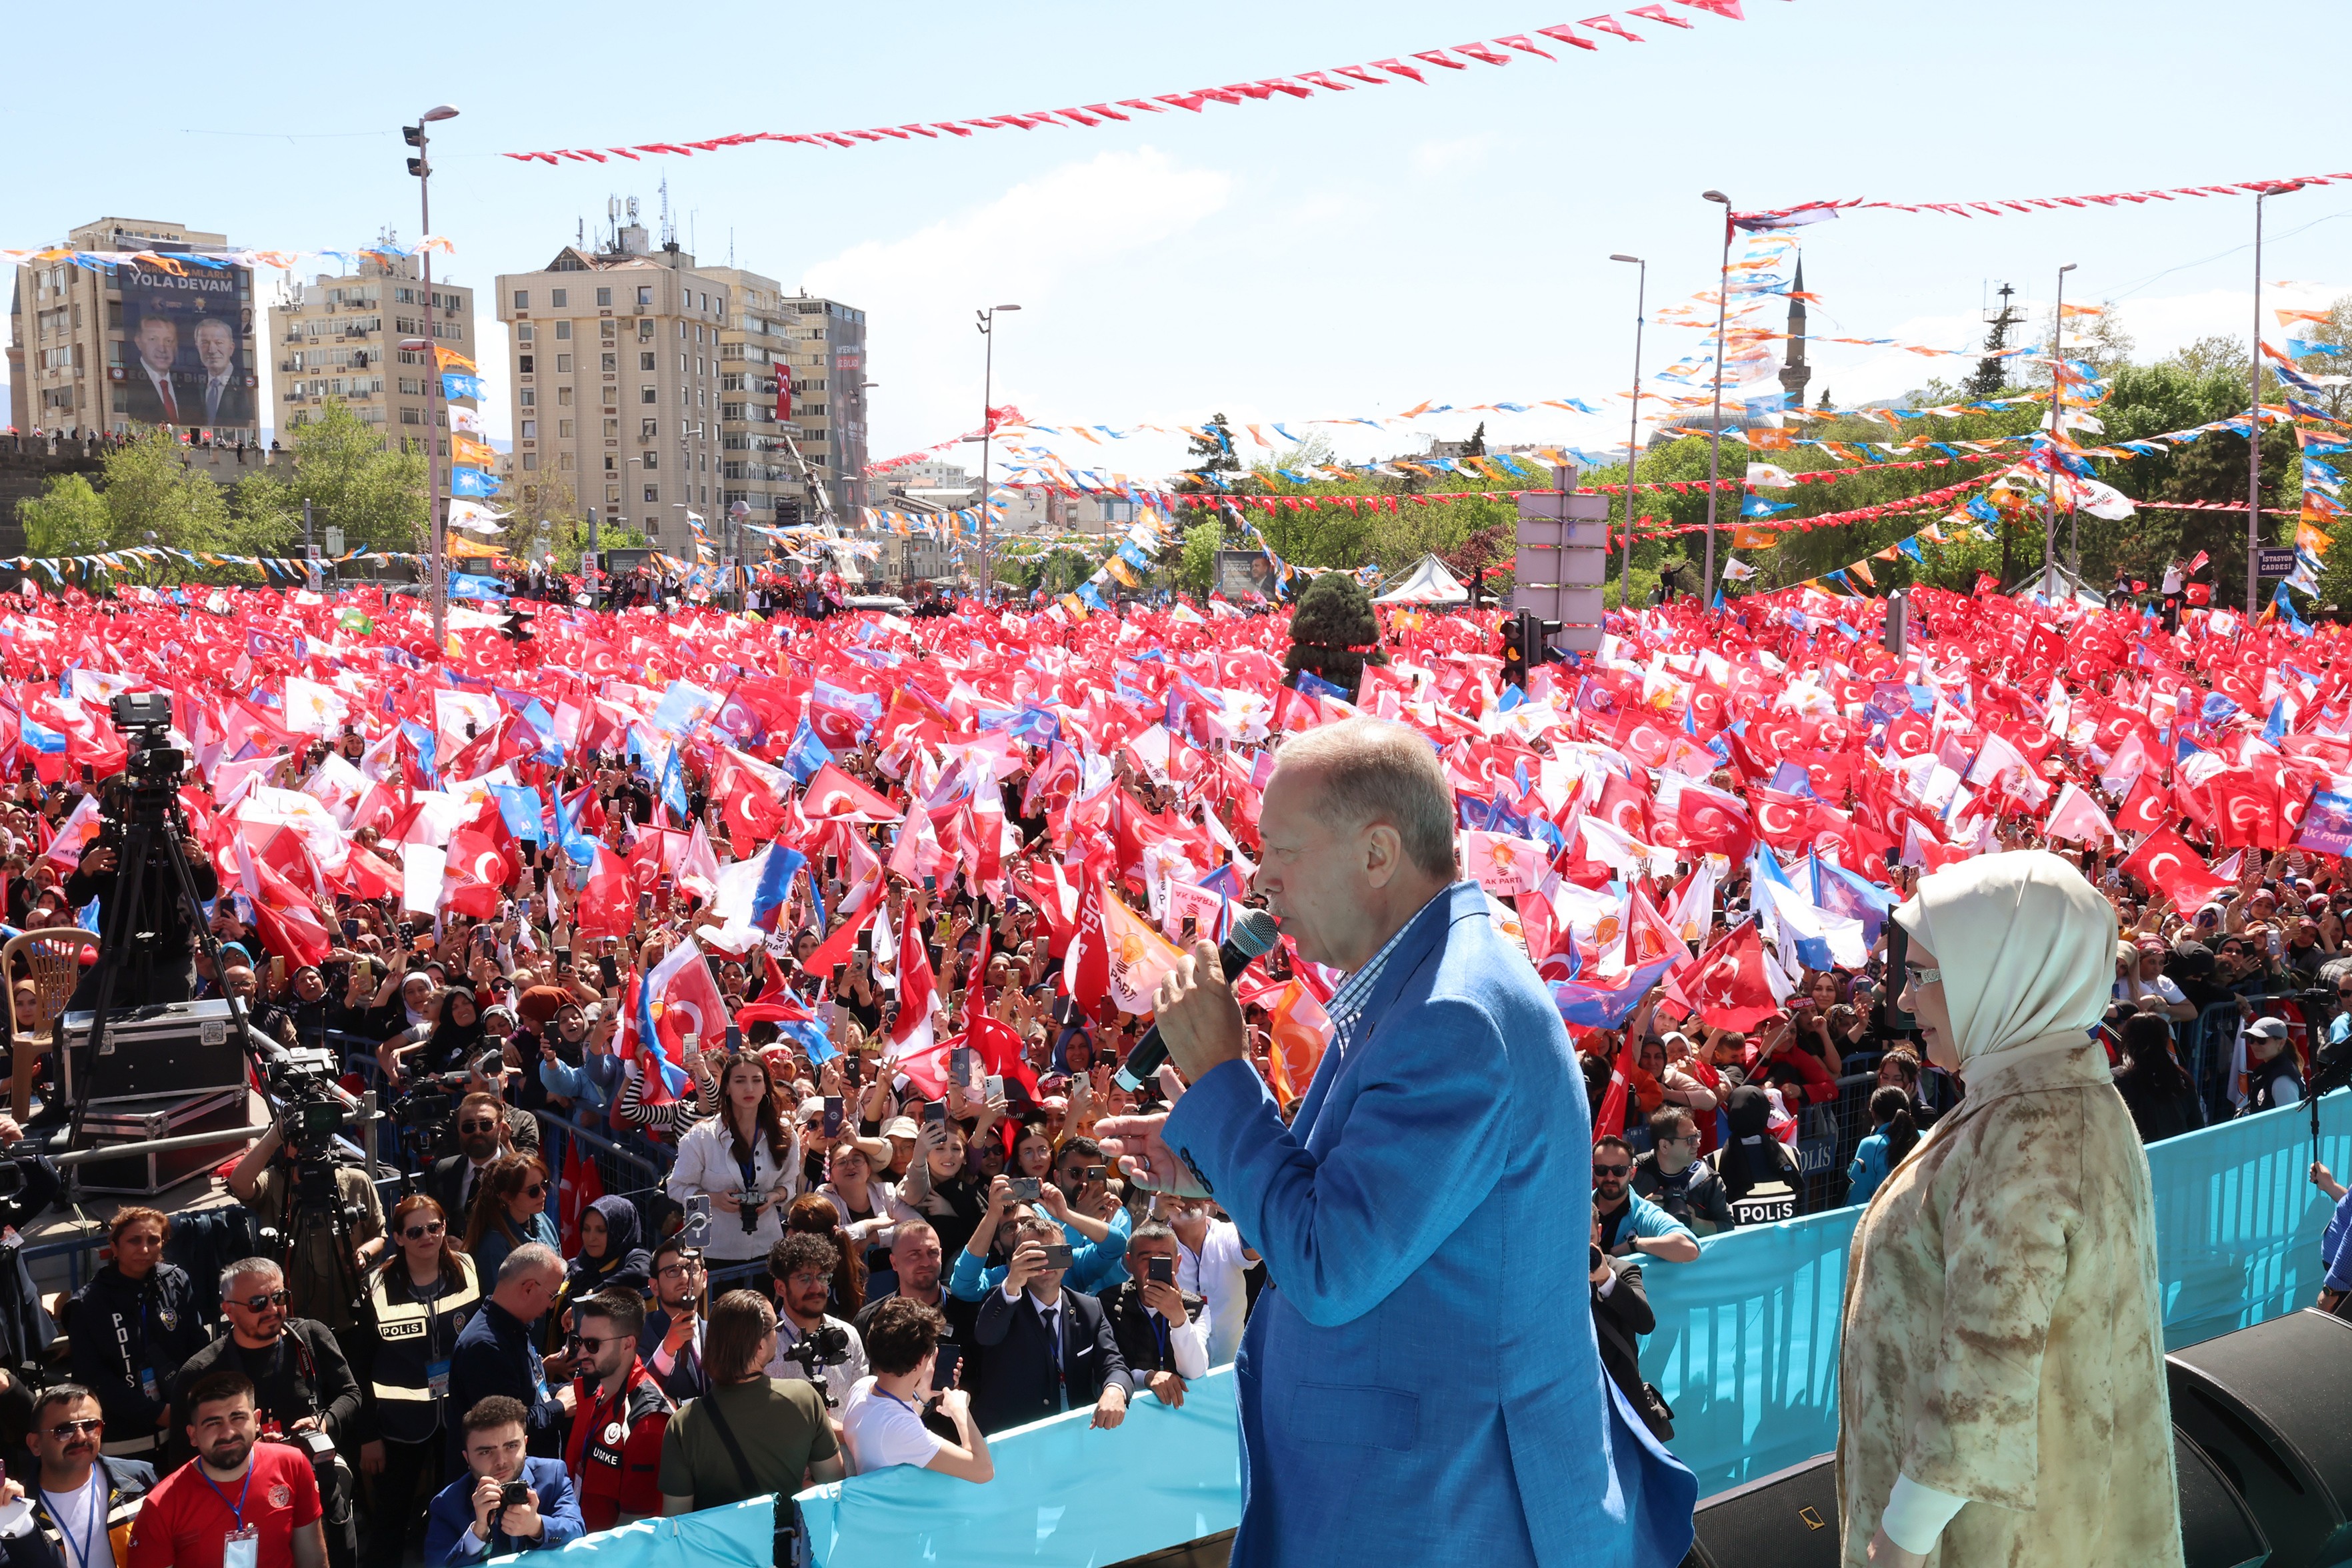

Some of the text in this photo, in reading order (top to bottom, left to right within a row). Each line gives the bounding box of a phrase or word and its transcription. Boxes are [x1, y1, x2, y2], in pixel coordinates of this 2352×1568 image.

[129, 273, 233, 292] YOLA DEVAM
[2261, 563, 2292, 571] CADDESİ
[1144, 759, 1154, 769] AK
[2303, 829, 2352, 846] AK PART
[1915, 859, 1925, 867] AK
[1799, 1142, 1831, 1171] OLİS
[300, 1347, 310, 1371] Canon
[593, 1446, 618, 1465] UMKE
